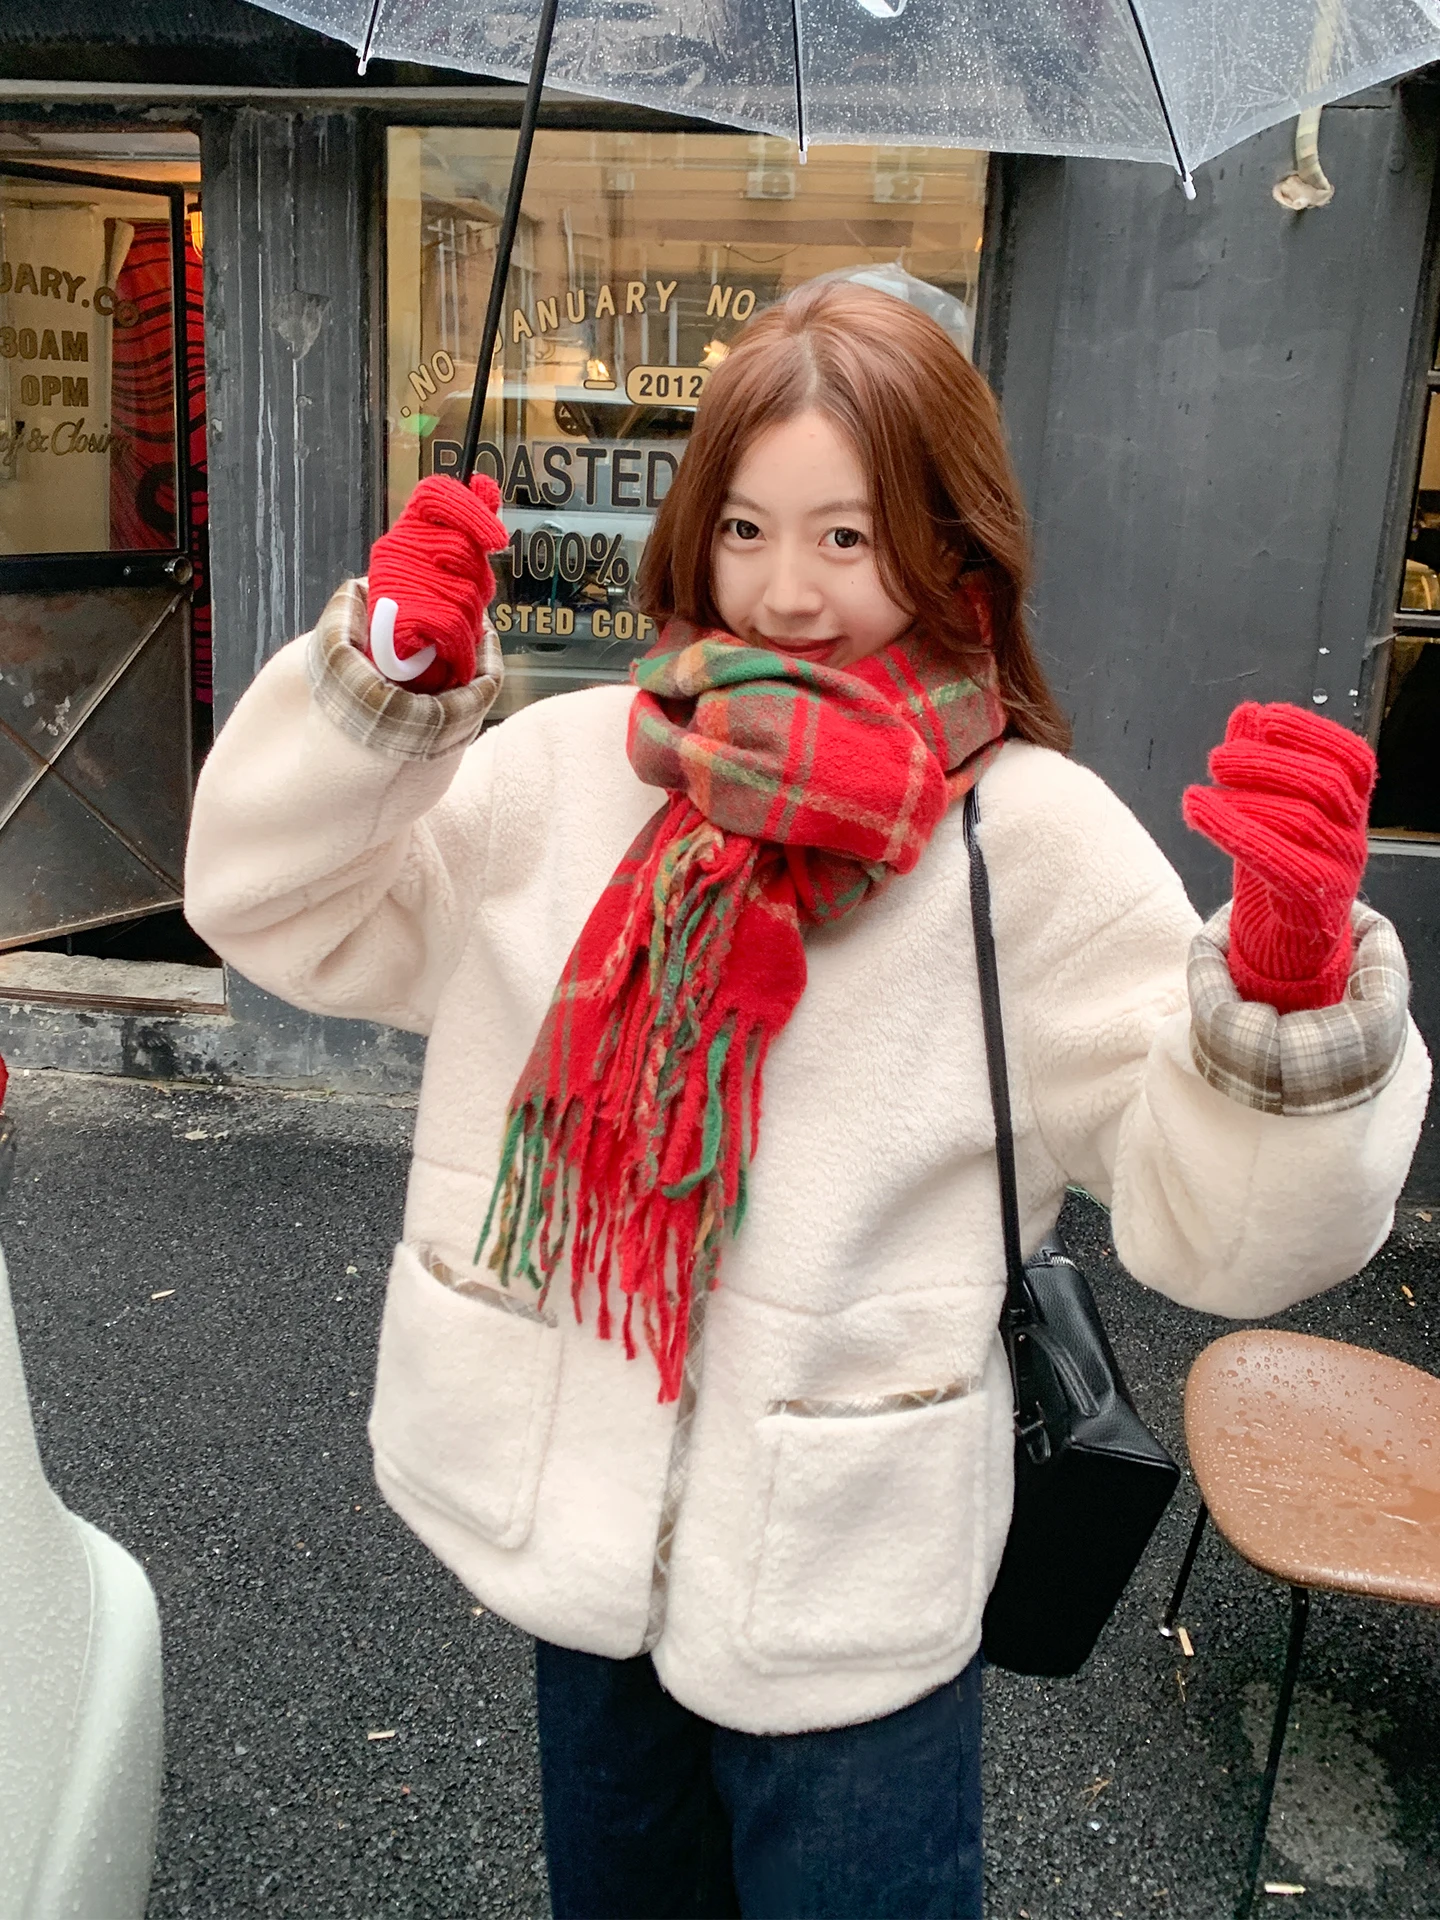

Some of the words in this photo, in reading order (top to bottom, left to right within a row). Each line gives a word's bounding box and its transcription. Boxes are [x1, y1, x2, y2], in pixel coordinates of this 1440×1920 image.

[408, 350, 456, 402] NO
[706, 284, 756, 321] NO
[639, 373, 703, 398] 2012
[26, 427, 49, 453] &
[509, 529, 630, 586] 100%
